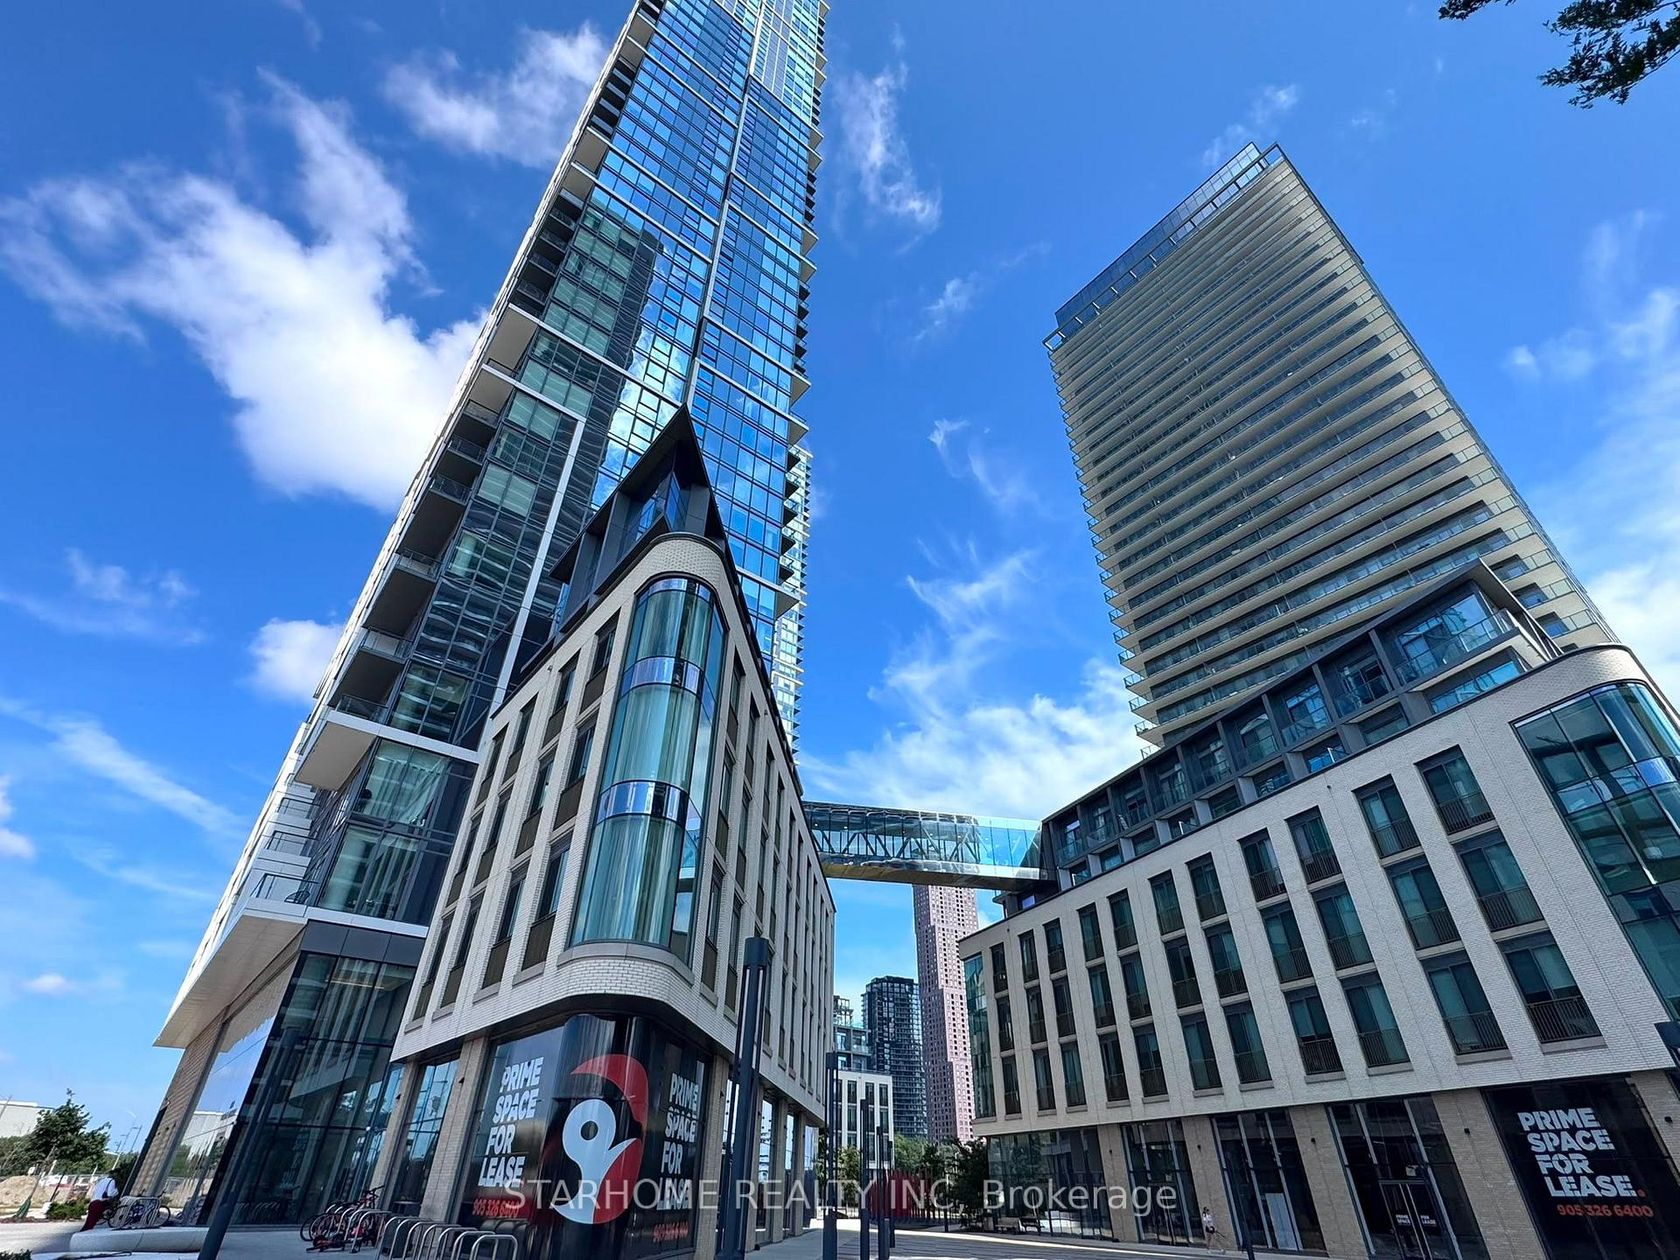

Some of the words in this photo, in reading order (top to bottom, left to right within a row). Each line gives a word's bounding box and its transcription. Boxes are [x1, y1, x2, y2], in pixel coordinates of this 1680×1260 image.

[500, 1057, 544, 1093] PRIME
[492, 1088, 539, 1124] SPACE
[669, 1073, 699, 1111] PRIME
[665, 1106, 697, 1142] SPACE
[1517, 1107, 1600, 1131] PRIME
[485, 1124, 515, 1155] FOR
[1527, 1129, 1615, 1152] SPACE
[661, 1141, 683, 1174] FOR
[1535, 1153, 1594, 1175] FOR
[1557, 1204, 1583, 1215] 905
[1586, 1205, 1612, 1216] 326
[1613, 1205, 1653, 1217] 6400
